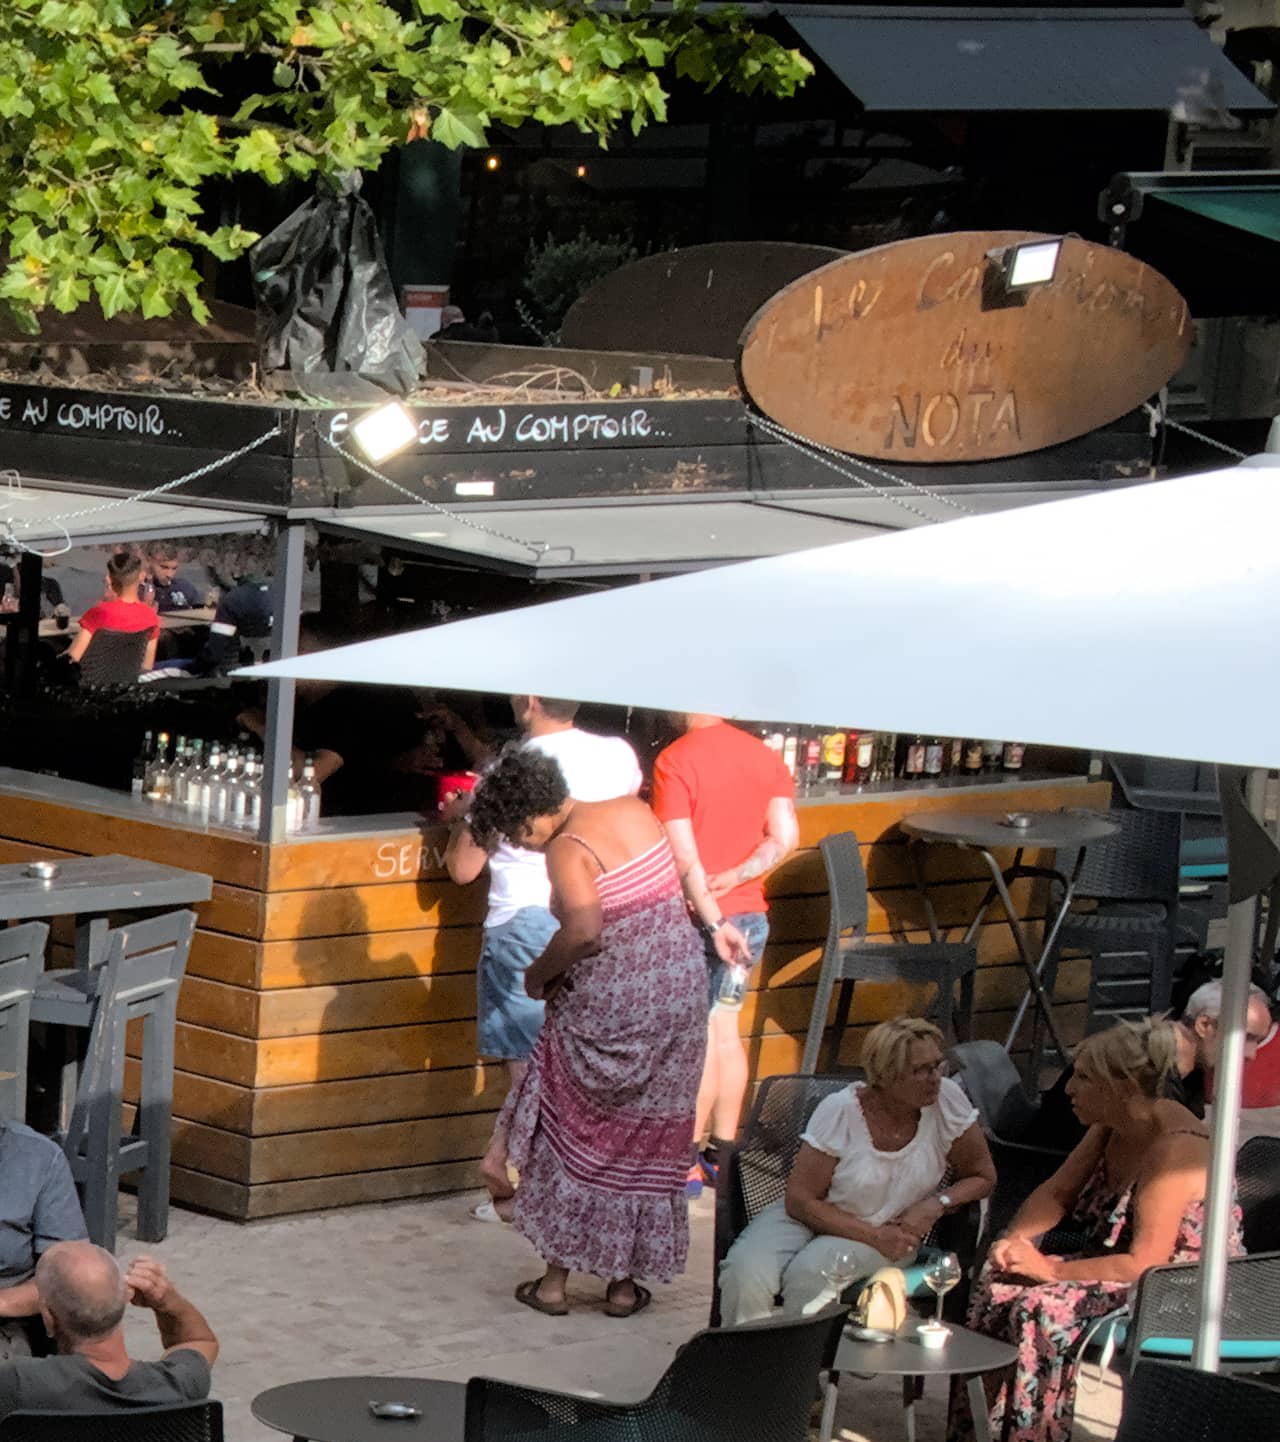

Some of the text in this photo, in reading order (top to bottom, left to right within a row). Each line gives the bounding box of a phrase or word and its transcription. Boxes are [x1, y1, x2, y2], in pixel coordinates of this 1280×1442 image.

[21, 397, 49, 426] AU
[466, 408, 507, 444] AU
[883, 388, 1023, 449] NOTA
